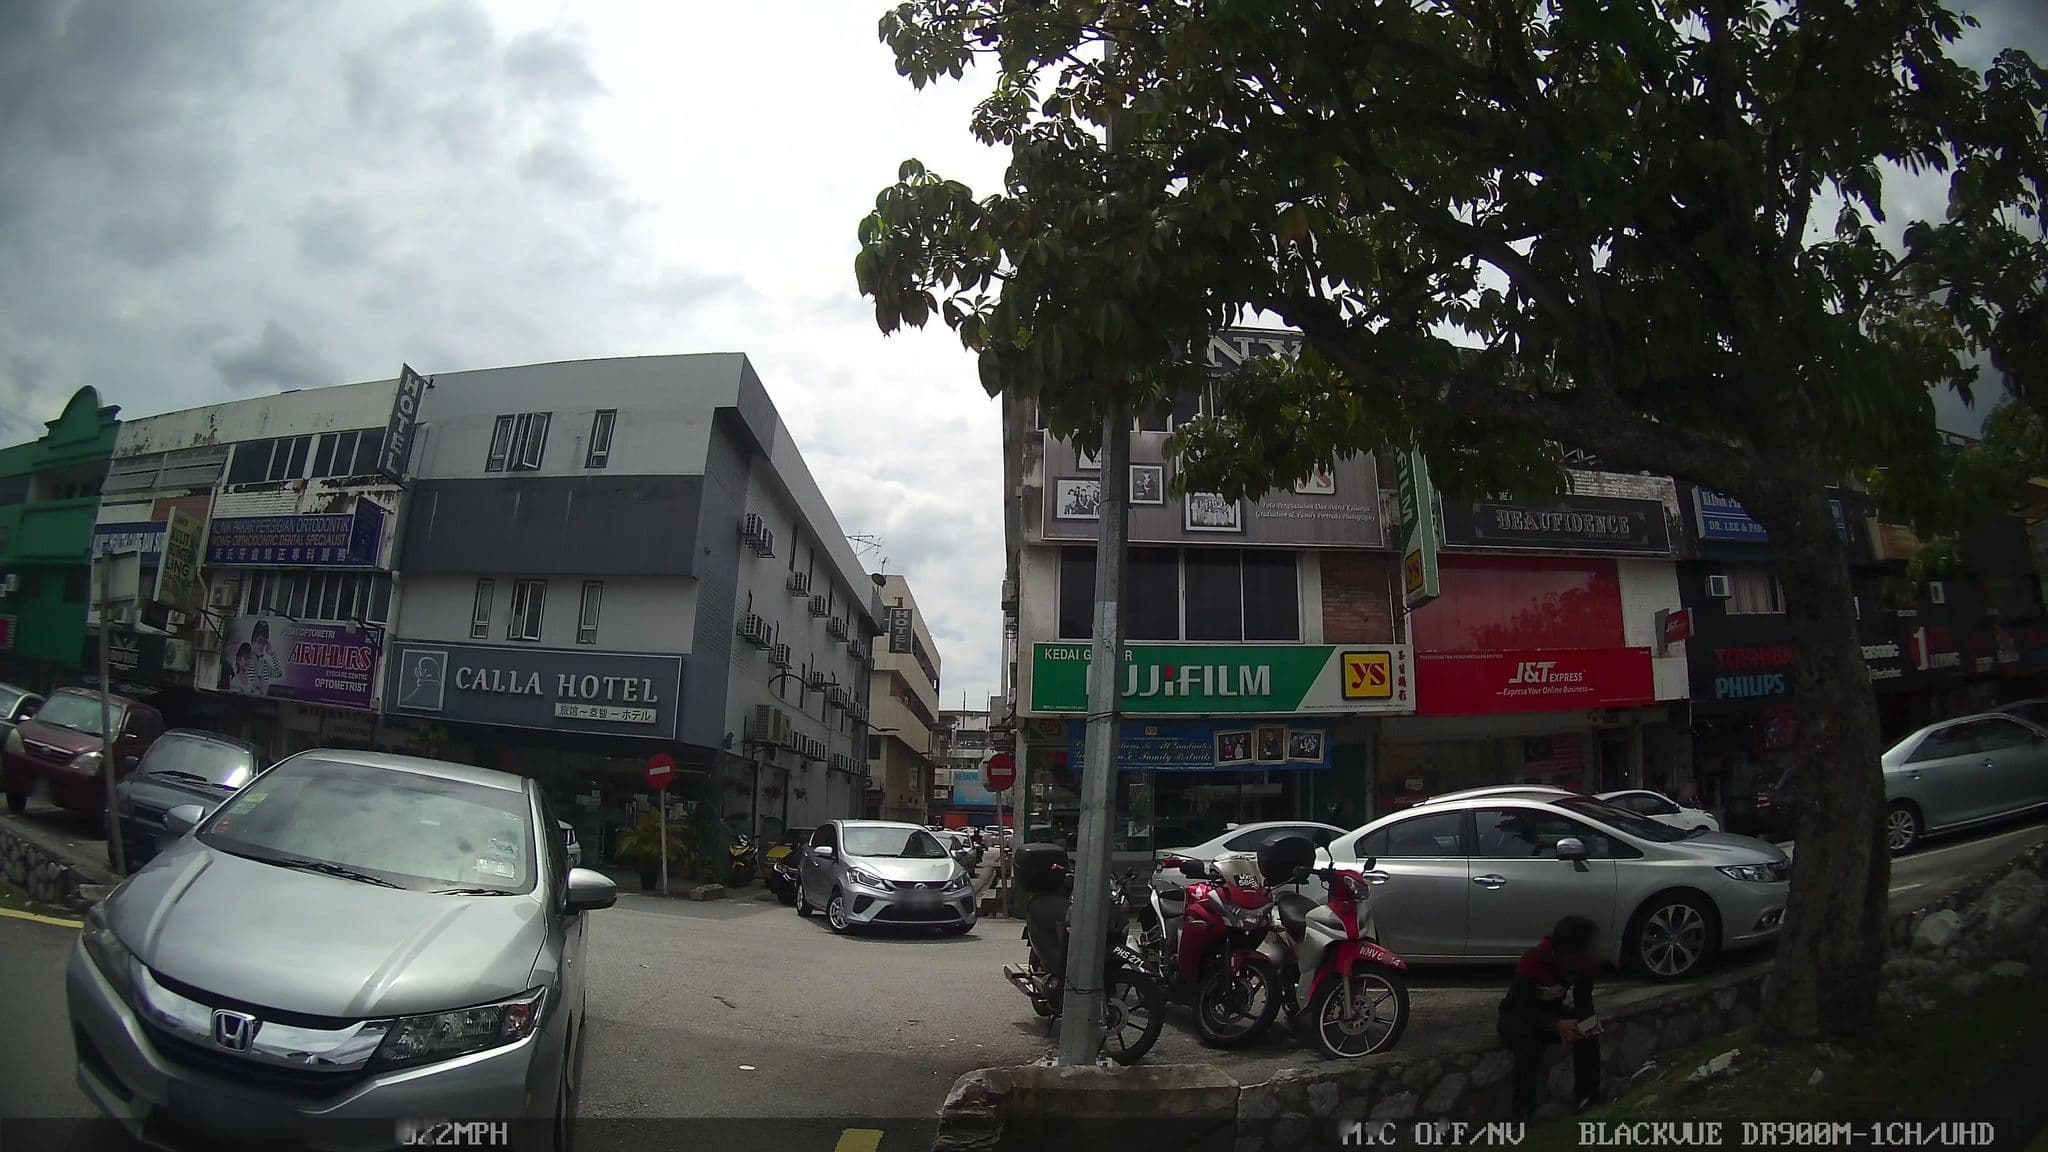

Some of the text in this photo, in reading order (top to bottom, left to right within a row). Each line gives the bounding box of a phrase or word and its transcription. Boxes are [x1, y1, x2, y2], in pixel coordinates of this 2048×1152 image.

[386, 373, 420, 474] HOTEL
[296, 517, 350, 533] ORTODONTIK
[279, 534, 304, 545] DENTAL
[305, 534, 346, 545] SPECIALIST
[1044, 649, 1079, 662] KEDAI
[1509, 661, 1583, 684] J&T EXPRESS
[314, 678, 368, 693] OPTOMETRIST
[455, 666, 659, 703] CALLA HOTEL
[1503, 688, 1528, 697] Express
[1528, 687, 1542, 696] Your
[1543, 686, 1563, 695] Online
[1714, 673, 1785, 700] PHILIPS
